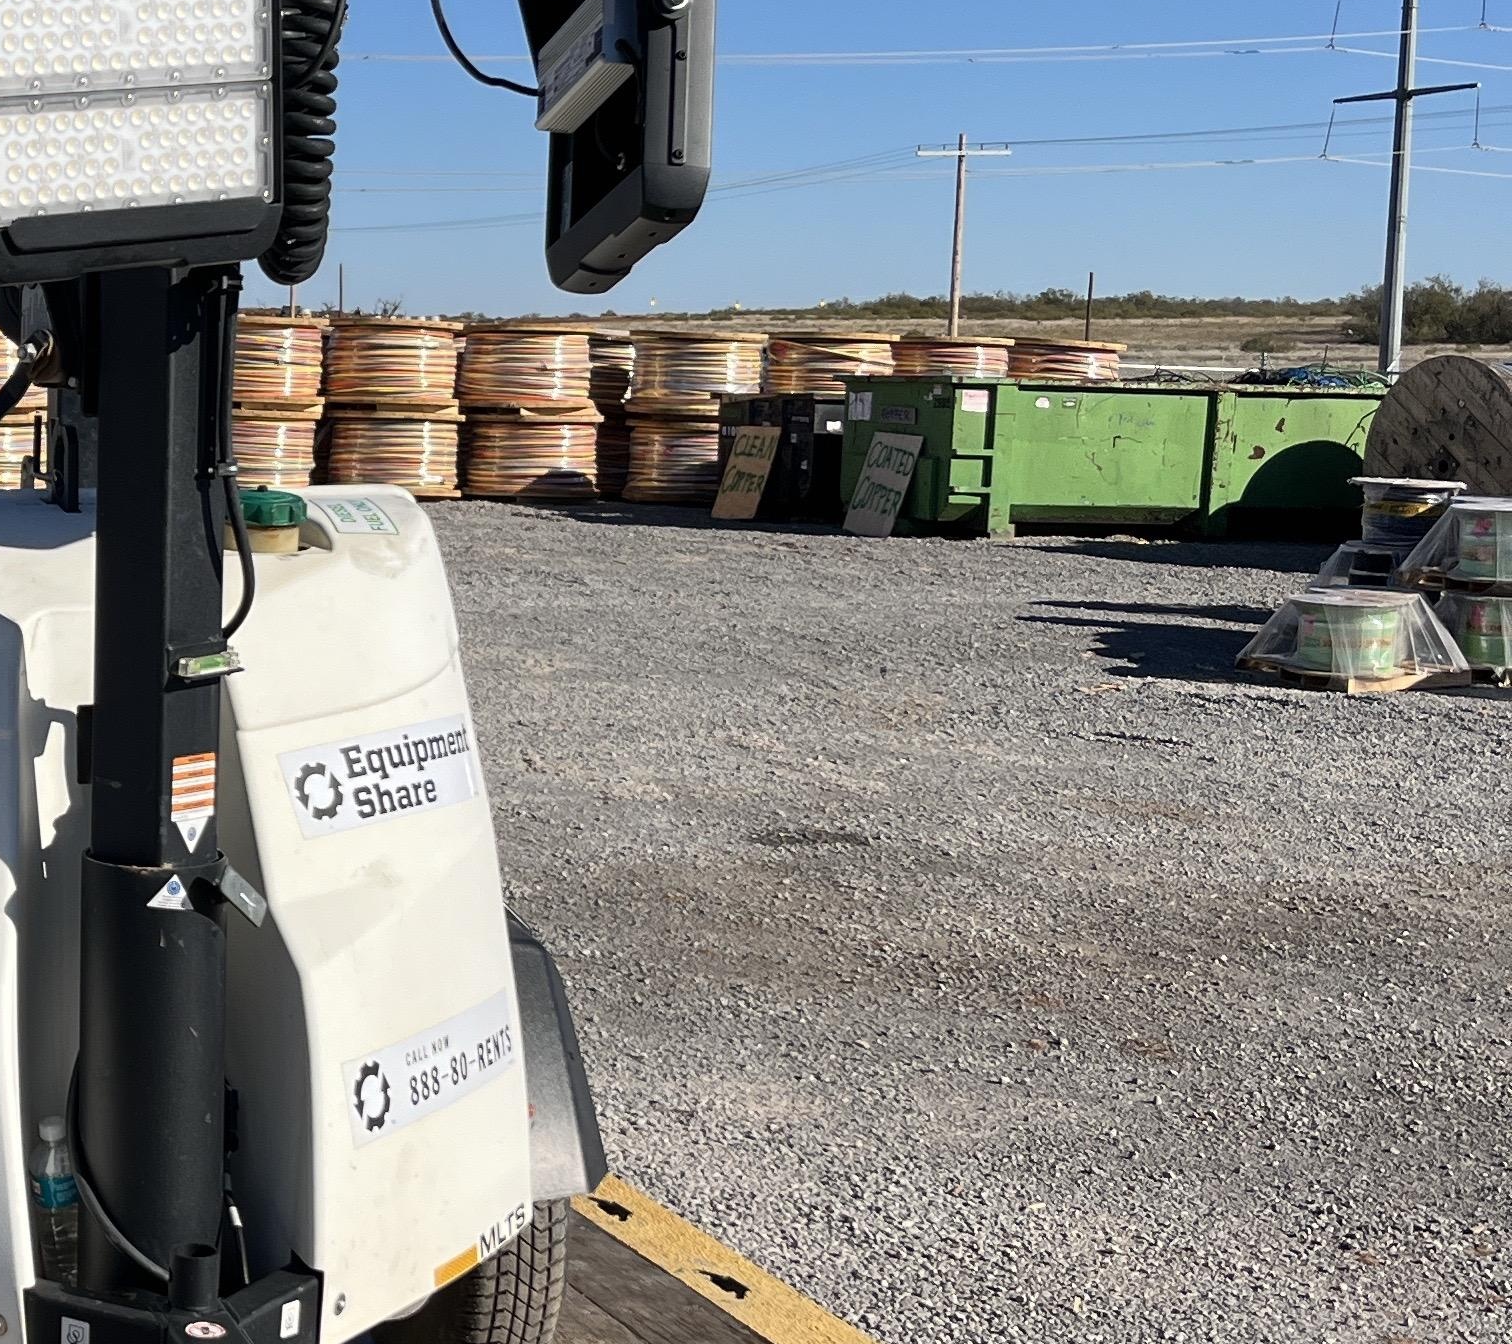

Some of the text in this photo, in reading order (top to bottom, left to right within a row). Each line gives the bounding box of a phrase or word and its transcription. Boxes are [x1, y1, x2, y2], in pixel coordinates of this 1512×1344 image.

[734, 434, 779, 461] CLEAN
[868, 441, 915, 477] COATED
[339, 722, 470, 780] Equipment
[352, 777, 438, 819] Share
[405, 1034, 450, 1066] CALL NOW
[409, 1024, 512, 1106] 888-80-RENTS
[480, 1201, 525, 1259] MLTS
